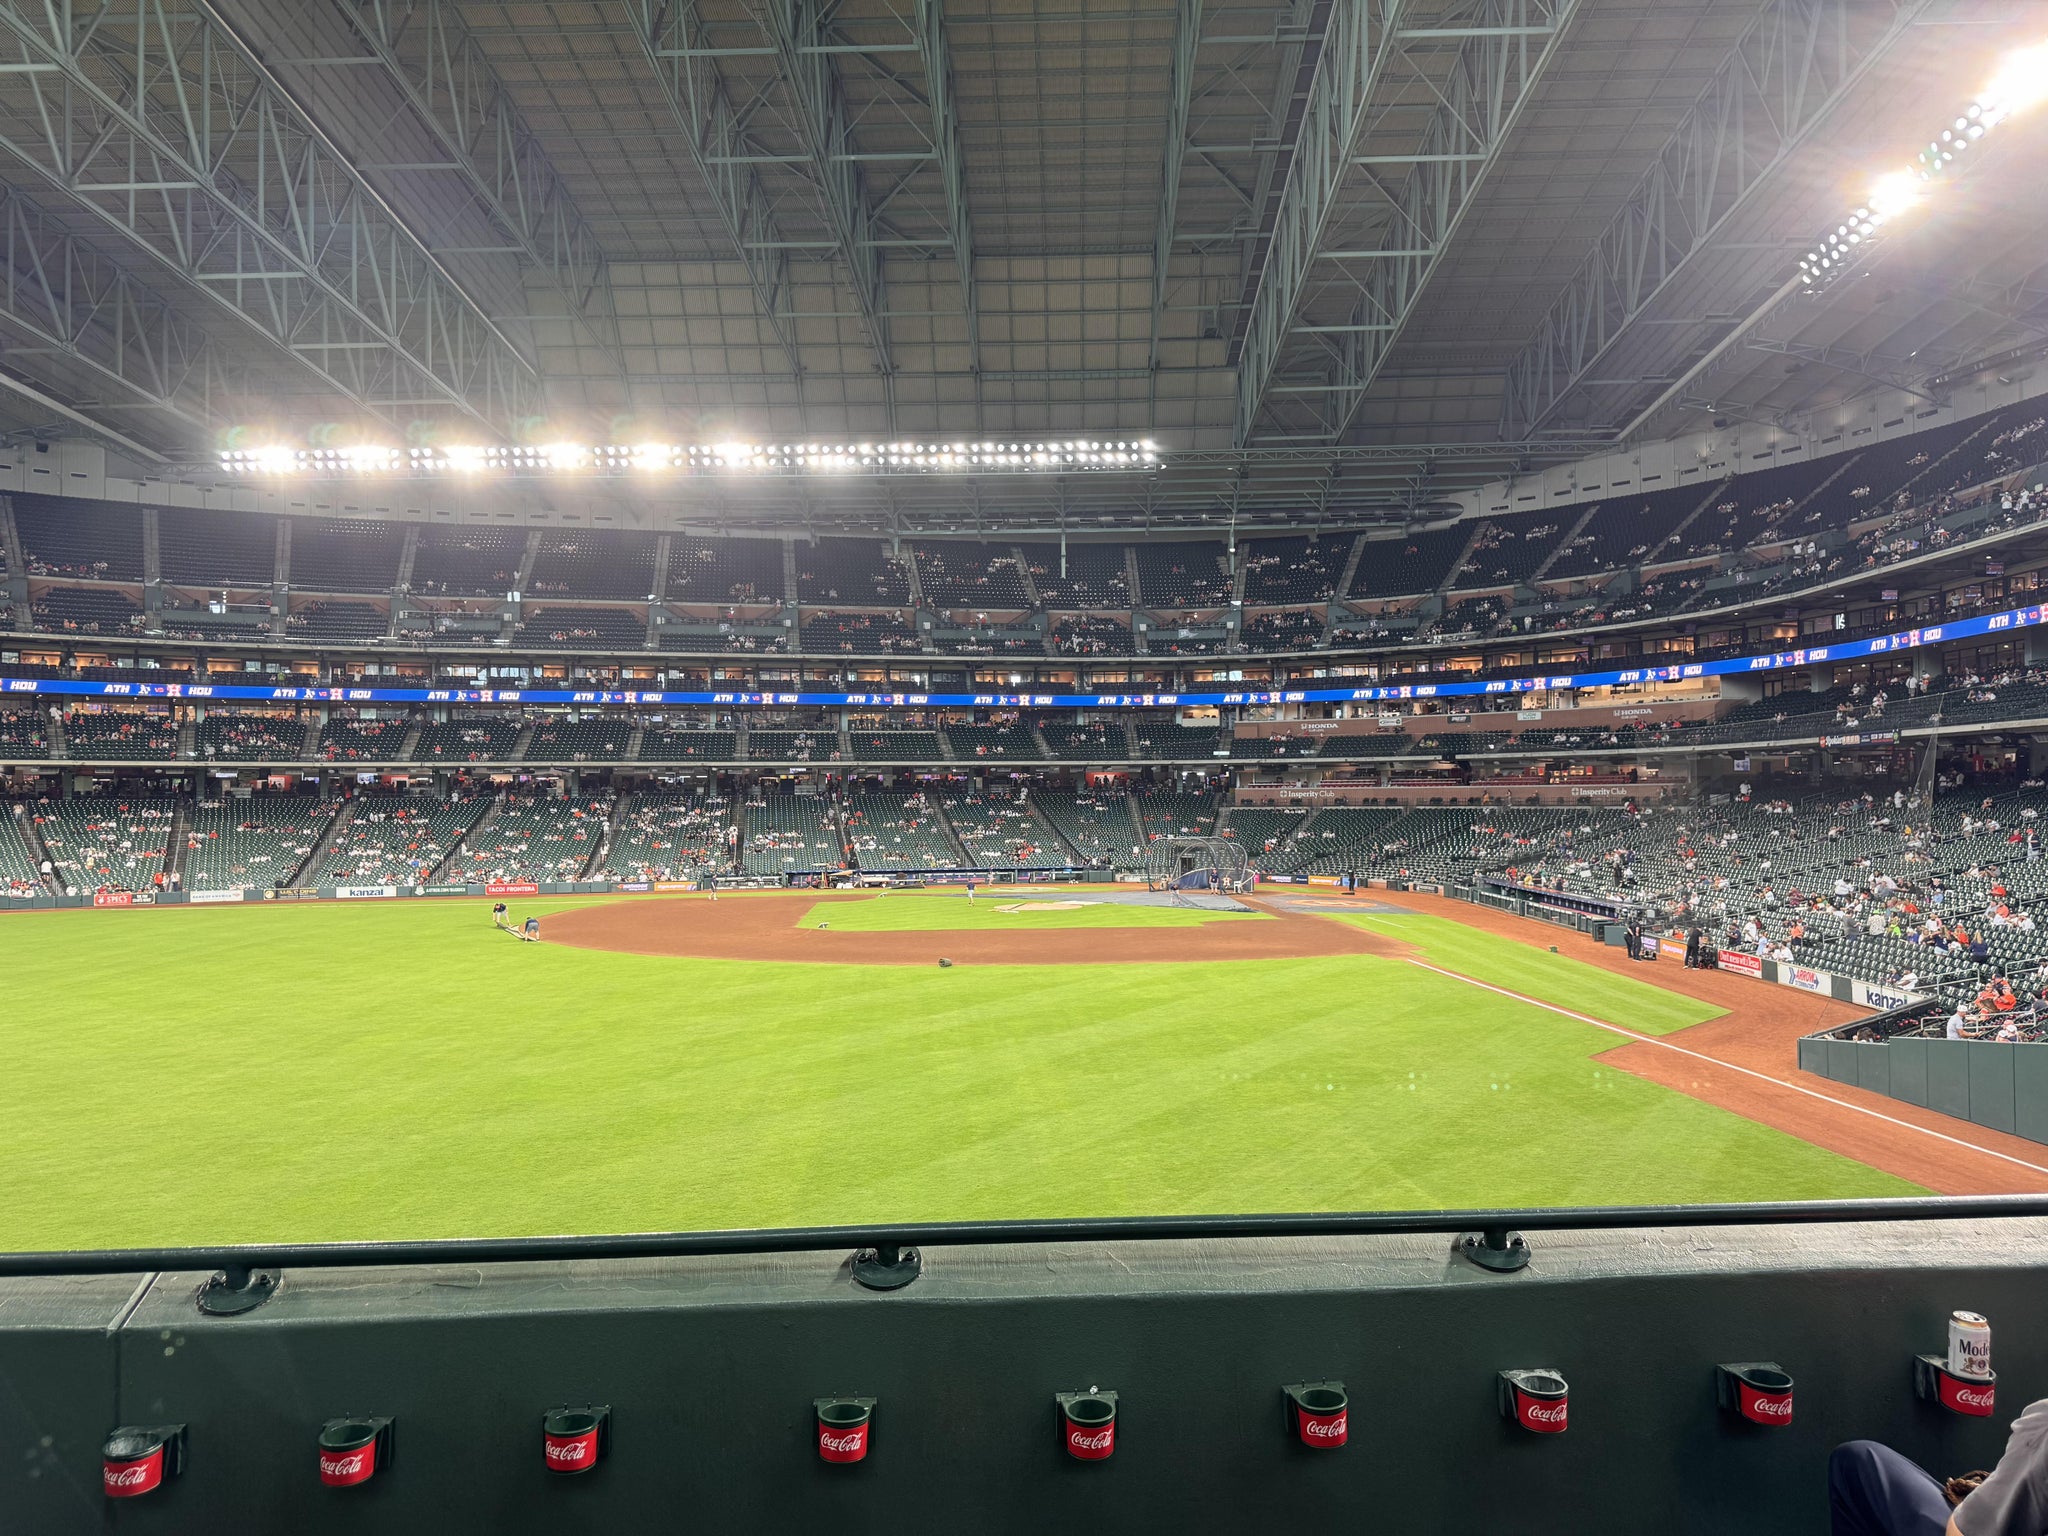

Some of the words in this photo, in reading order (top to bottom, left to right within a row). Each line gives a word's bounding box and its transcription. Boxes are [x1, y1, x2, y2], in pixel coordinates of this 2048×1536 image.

[1988, 614, 2009, 629] ATH
[1870, 639, 1886, 651] ATH
[1923, 627, 1942, 641] HOU
[1750, 658, 1770, 668] ATH
[1809, 649, 1827, 660] HOU
[1619, 672, 1639, 682] ATH
[1684, 665, 1702, 675] HOU
[10, 681, 37, 690] HOU
[1485, 682, 1505, 691] ATH
[1551, 677, 1571, 687] HOU
[104, 685, 130, 694] ATH
[188, 687, 213, 695] HOU
[273, 689, 296, 698] ATH
[349, 690, 371, 699] HOU
[1353, 690, 1372, 698] ATH
[1416, 686, 1436, 695] HOU
[427, 691, 449, 699] ATH
[499, 692, 520, 700] HOU
[573, 693, 594, 701] ATH
[642, 693, 662, 702] HOU
[713, 694, 733, 702] ATH
[779, 694, 798, 702] HOU
[847, 695, 866, 703] ATH
[909, 695, 927, 703] HOU
[974, 696, 992, 704] ATH
[1035, 696, 1052, 704] HOU
[1098, 696, 1116, 704] ATH
[1158, 696, 1177, 704] HOU
[1223, 694, 1242, 702] ATH
[1286, 693, 1304, 701] HOU
[1580, 788, 1611, 797] Insperity
[1307, 1416, 1346, 1437] Coca-Cola
[821, 1432, 863, 1452] Coca-Cola
[1071, 1429, 1112, 1449] Coca-Cola
